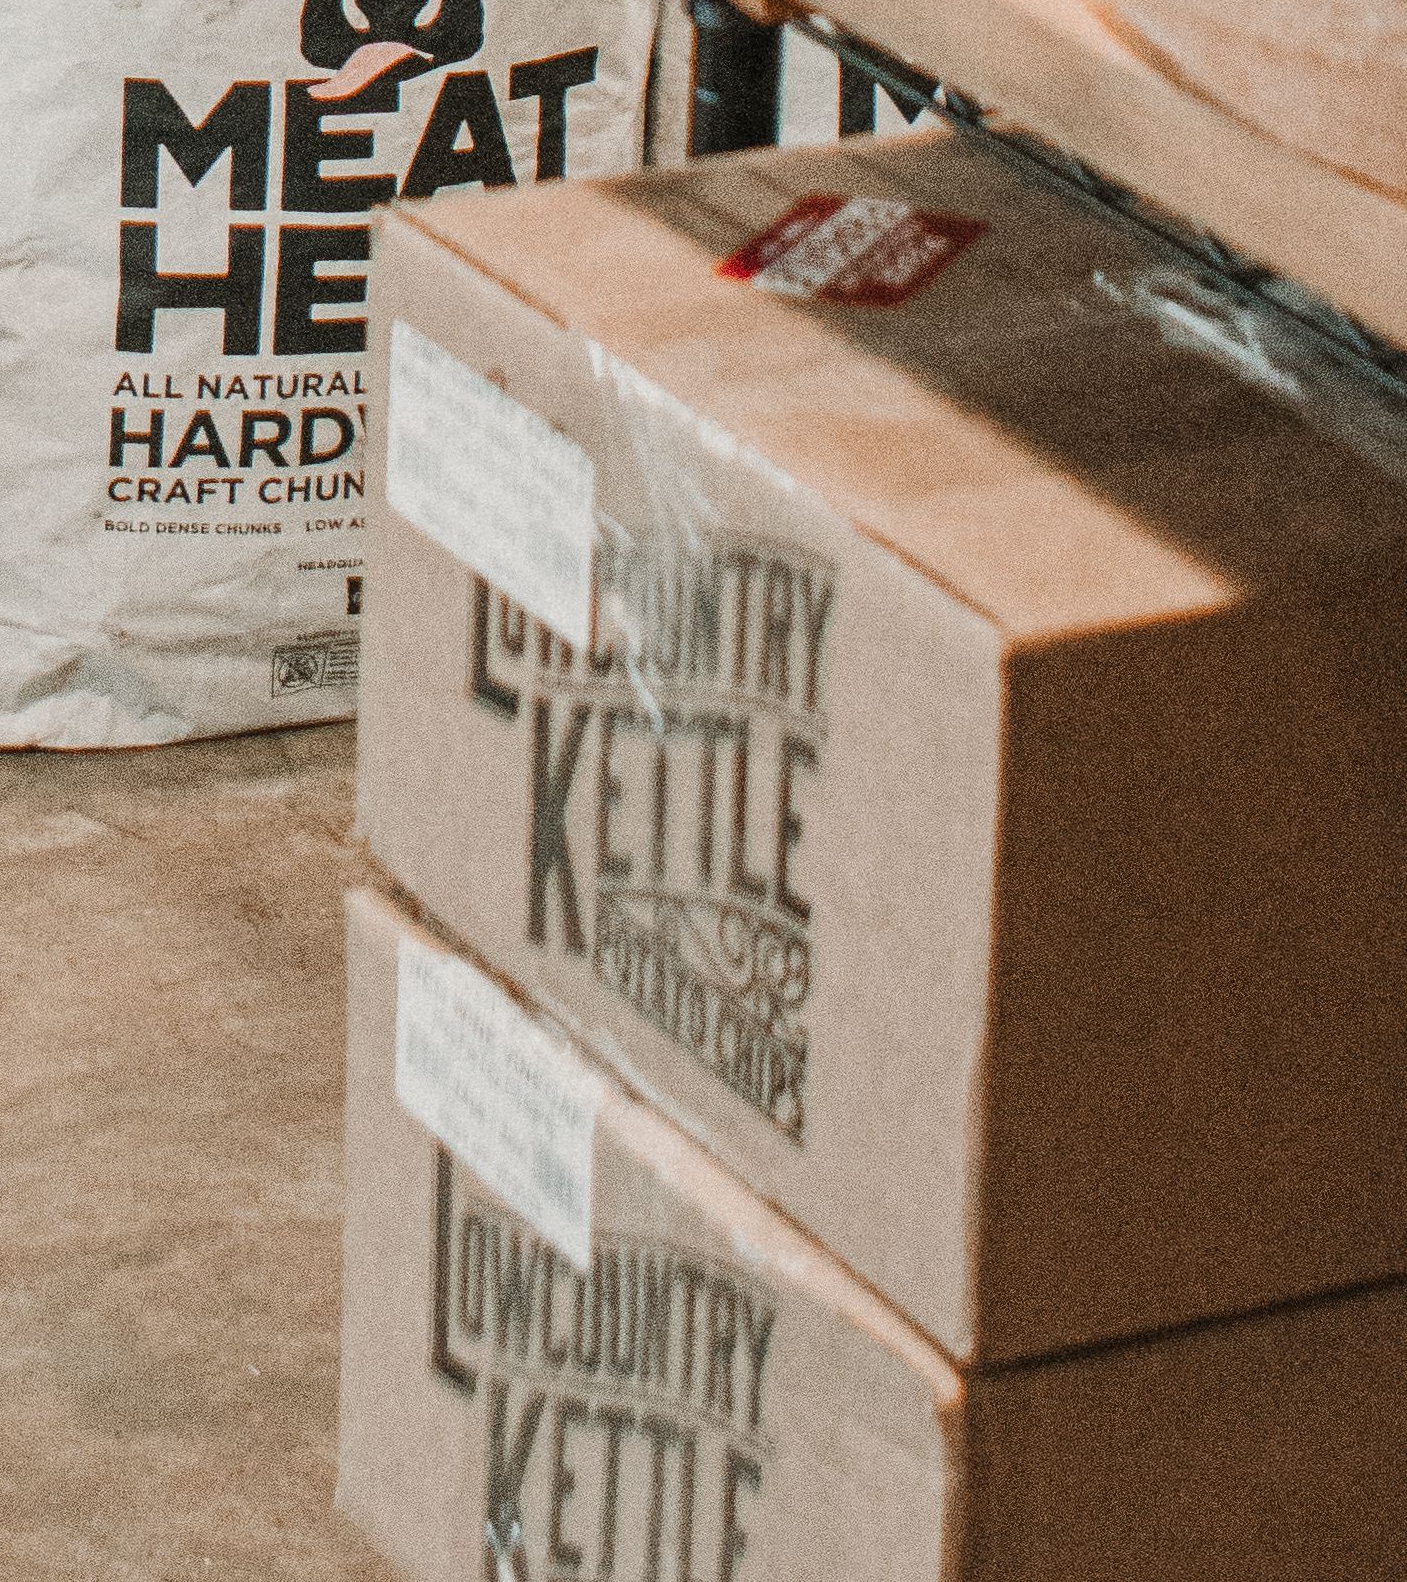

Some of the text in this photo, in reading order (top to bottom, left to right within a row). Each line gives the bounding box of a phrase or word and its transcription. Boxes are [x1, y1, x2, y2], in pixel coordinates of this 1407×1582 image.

[118, 45, 599, 214] MEAT
[112, 220, 373, 357] HE
[112, 369, 370, 401] ALL NATURAL
[108, 402, 365, 469] HARD
[107, 469, 366, 506] CRAFT CHUN
[103, 517, 344, 536] BOLD DENSE CHUNKS LOW
[527, 696, 821, 956] KETTLE
